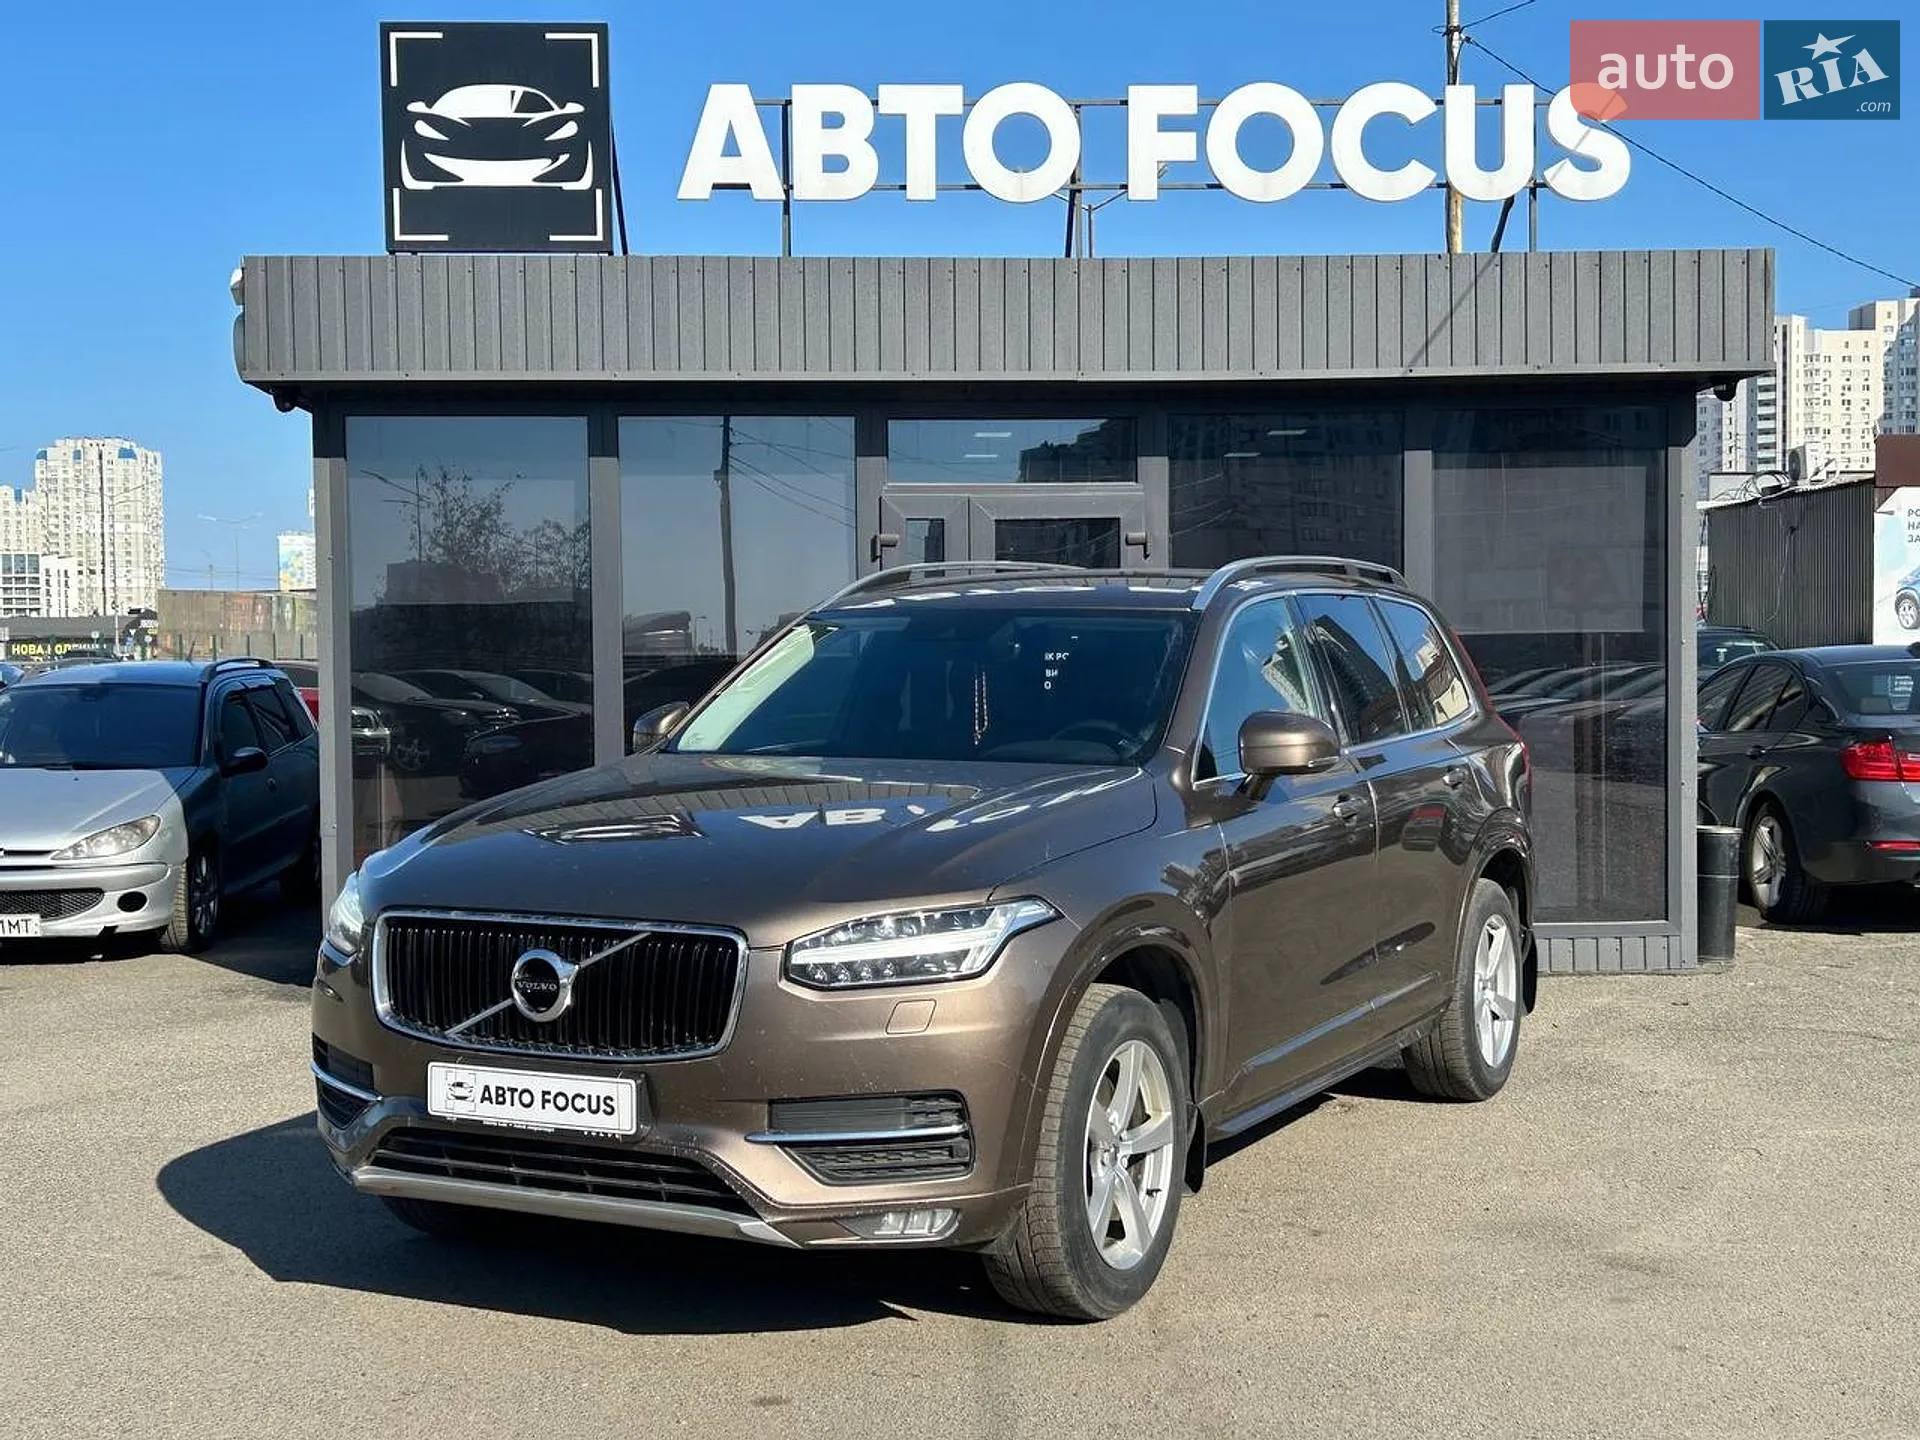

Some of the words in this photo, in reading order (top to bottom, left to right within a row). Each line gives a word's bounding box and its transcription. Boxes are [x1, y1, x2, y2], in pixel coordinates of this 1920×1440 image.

[677, 82, 1082, 202] АВТО
[1127, 82, 1631, 202] FOCUS
[516, 980, 558, 992] VOLVO
[480, 1084, 535, 1109] АВТО
[541, 1090, 616, 1117] FOCUS
